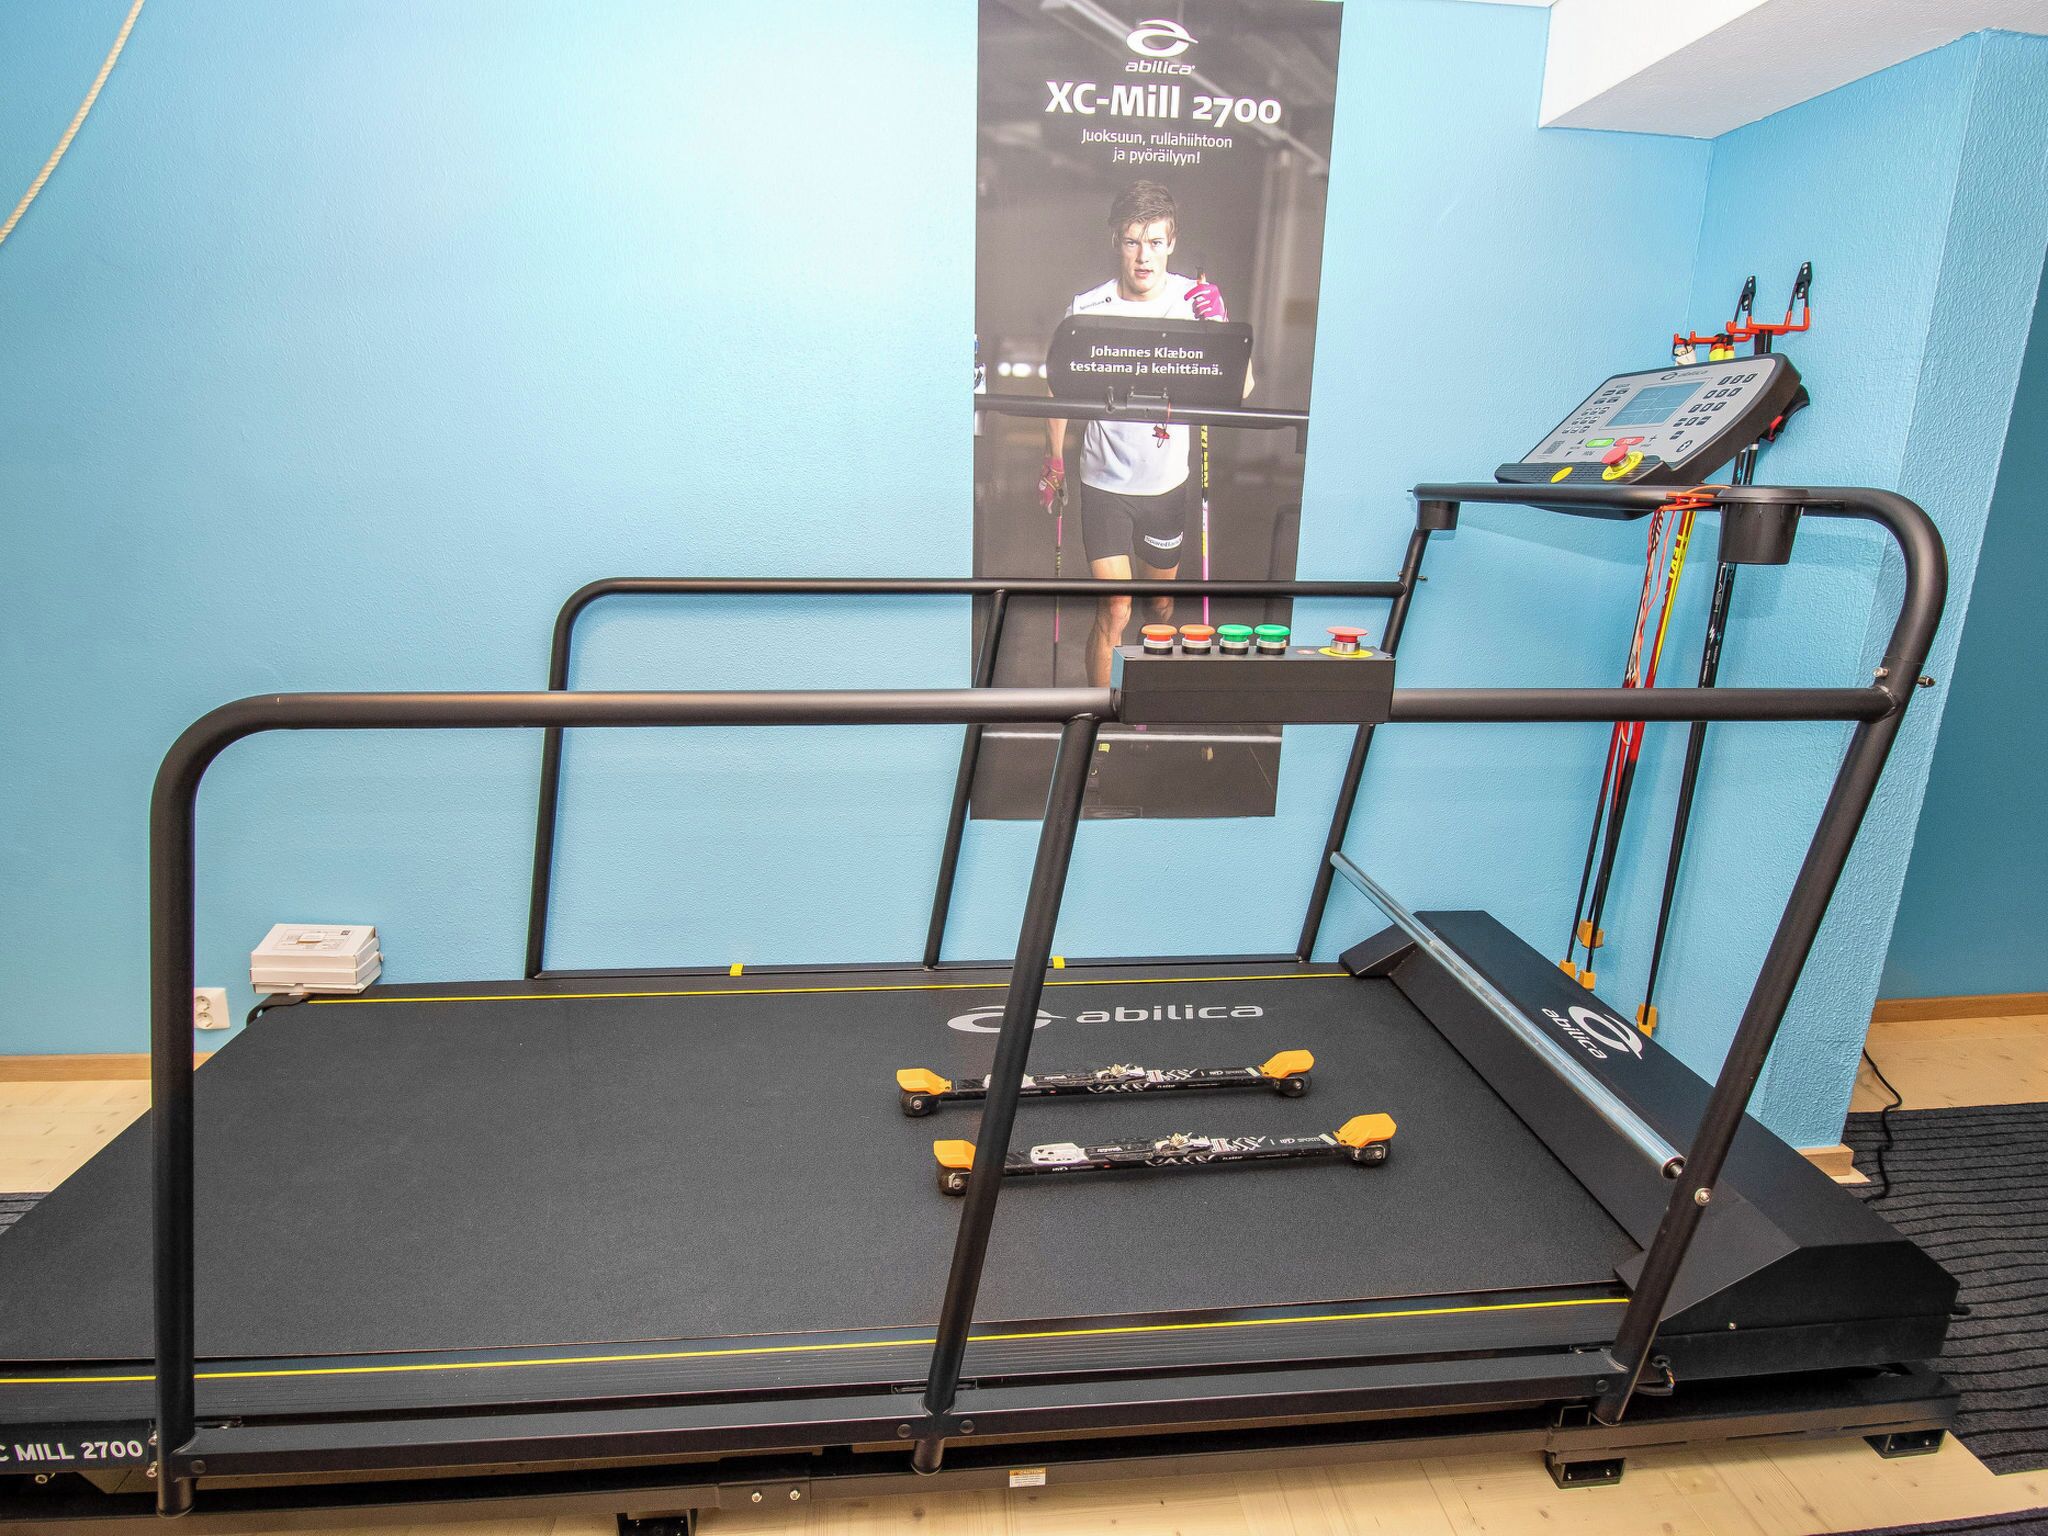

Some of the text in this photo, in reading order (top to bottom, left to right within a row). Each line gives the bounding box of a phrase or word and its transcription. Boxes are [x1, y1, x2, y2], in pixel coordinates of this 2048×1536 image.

[1125, 60, 1192, 75] abilica
[1045, 80, 1281, 127] XC-Mill 2700
[1081, 128, 1232, 148] Juoksuun, rullahiihtoon
[1112, 147, 1201, 164] ja pyöräilyyn!
[1091, 345, 1203, 359] Johannes Klæbon
[1070, 361, 1223, 375] testaama ja kehittämä.
[1076, 1005, 1264, 1023] abilica
[1541, 1008, 1608, 1059] abilica
[14, 1443, 75, 1461] MILL
[80, 1440, 143, 1459] 2700
